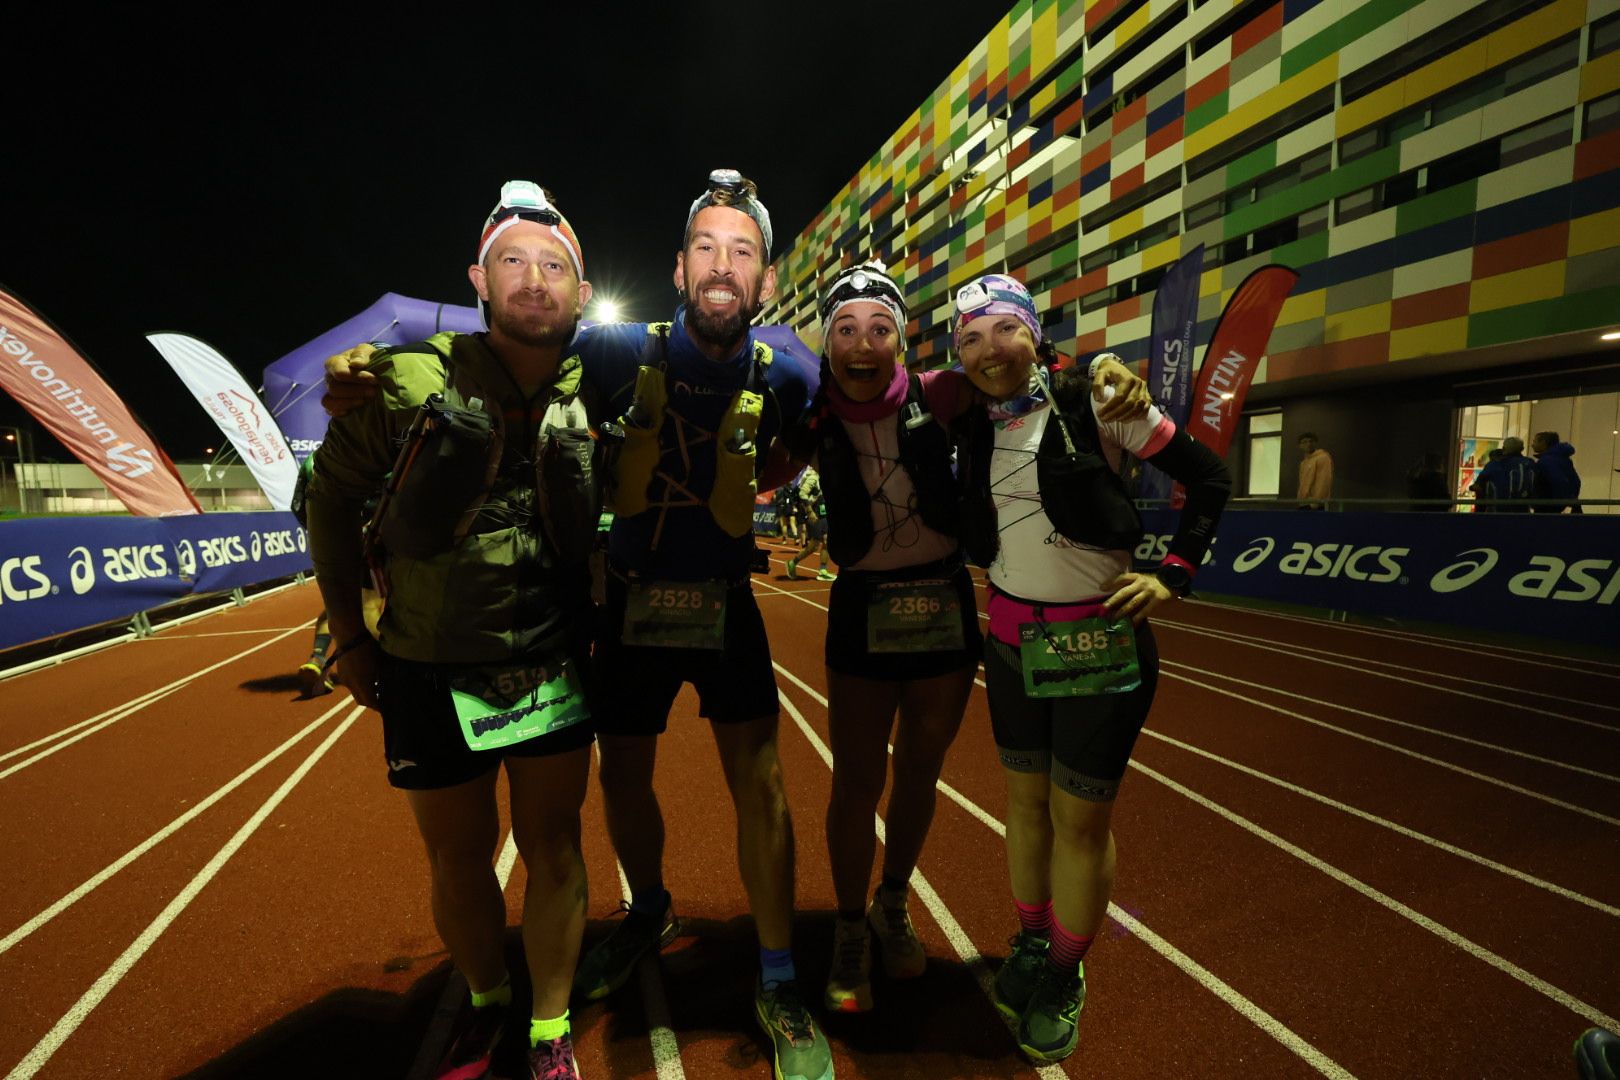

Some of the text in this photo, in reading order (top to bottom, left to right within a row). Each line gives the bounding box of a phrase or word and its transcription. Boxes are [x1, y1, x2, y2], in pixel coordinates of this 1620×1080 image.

[1203, 350, 1246, 432] ANITIN
[102, 544, 168, 582] asics
[198, 536, 248, 568] asics
[263, 530, 296, 557] asics
[1279, 541, 1411, 584] asics
[649, 589, 704, 609] 2528
[889, 596, 941, 615] 2366
[1045, 630, 1109, 654] 2185
